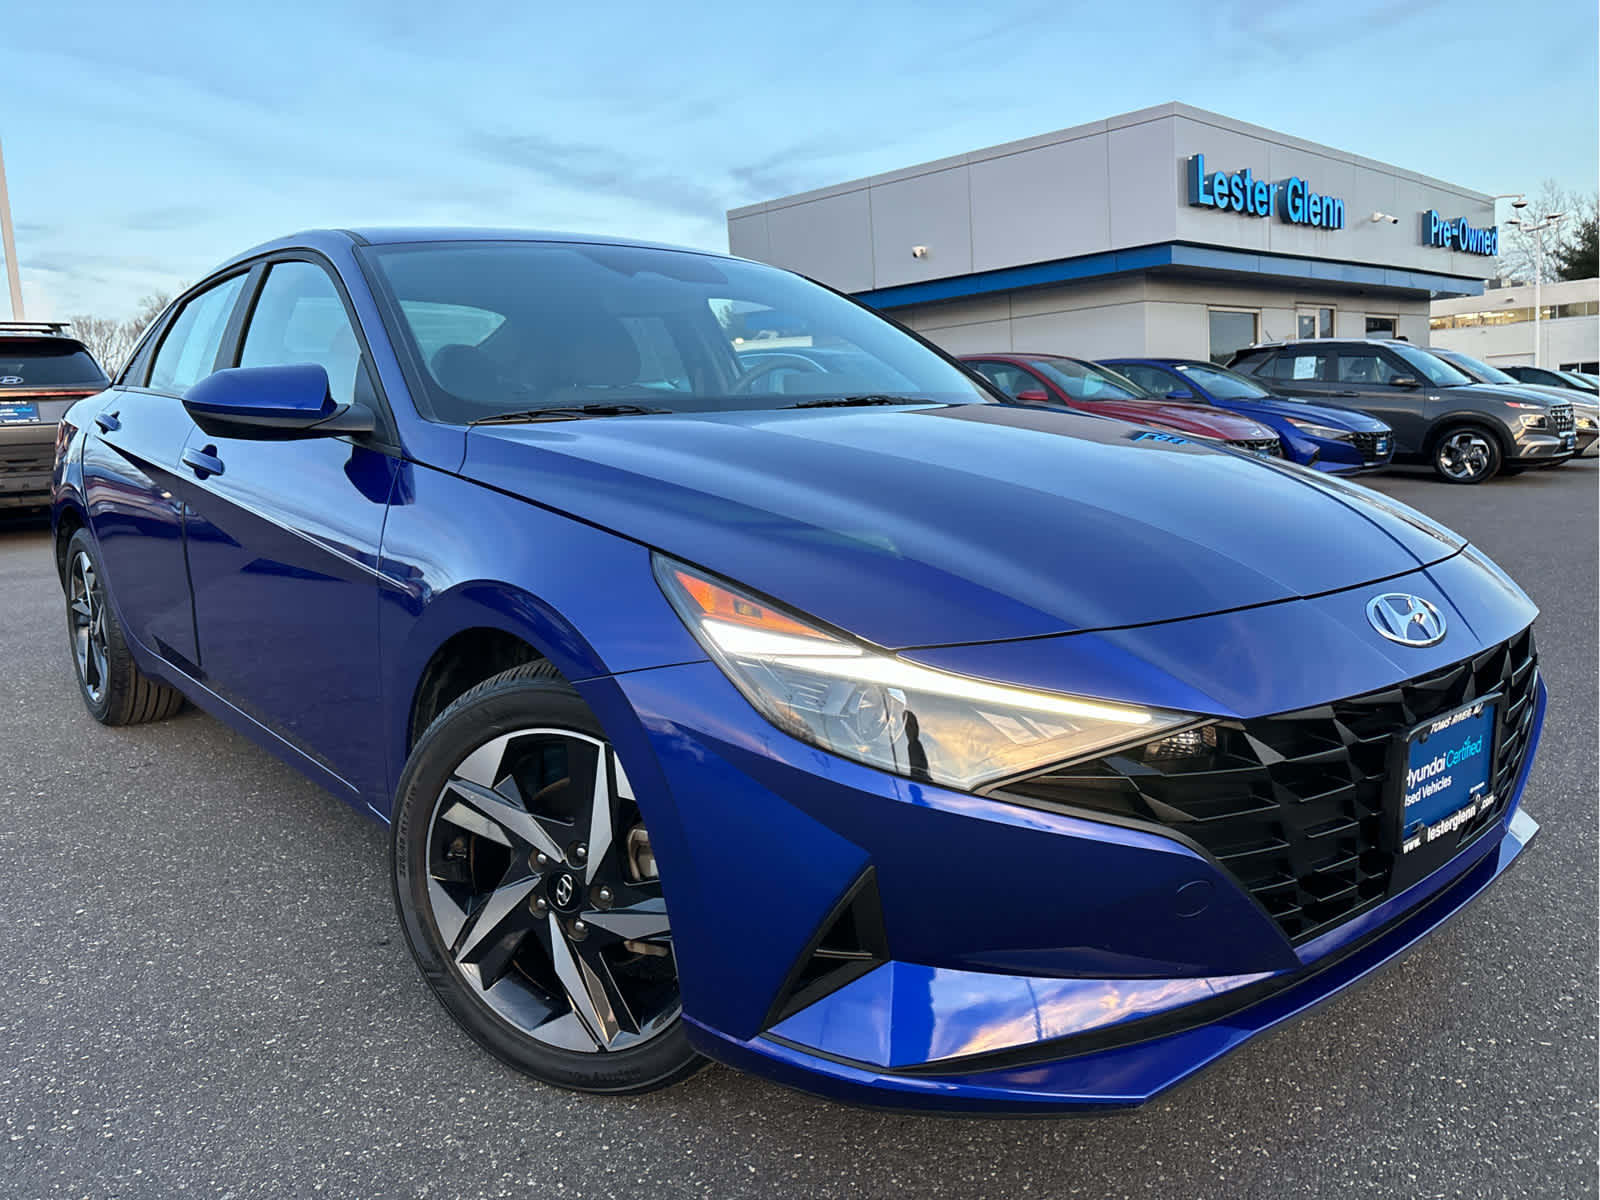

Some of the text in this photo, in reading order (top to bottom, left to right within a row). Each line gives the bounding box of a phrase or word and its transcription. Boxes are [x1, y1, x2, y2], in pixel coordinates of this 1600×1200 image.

[1190, 153, 1345, 230] Lester Glenn
[1429, 209, 1499, 257] Pre-Owned
[1446, 735, 1483, 768] Certified
[1422, 775, 1452, 799] Vehicles
[1427, 804, 1476, 842] lesterglenn
[1481, 794, 1495, 811] .com
